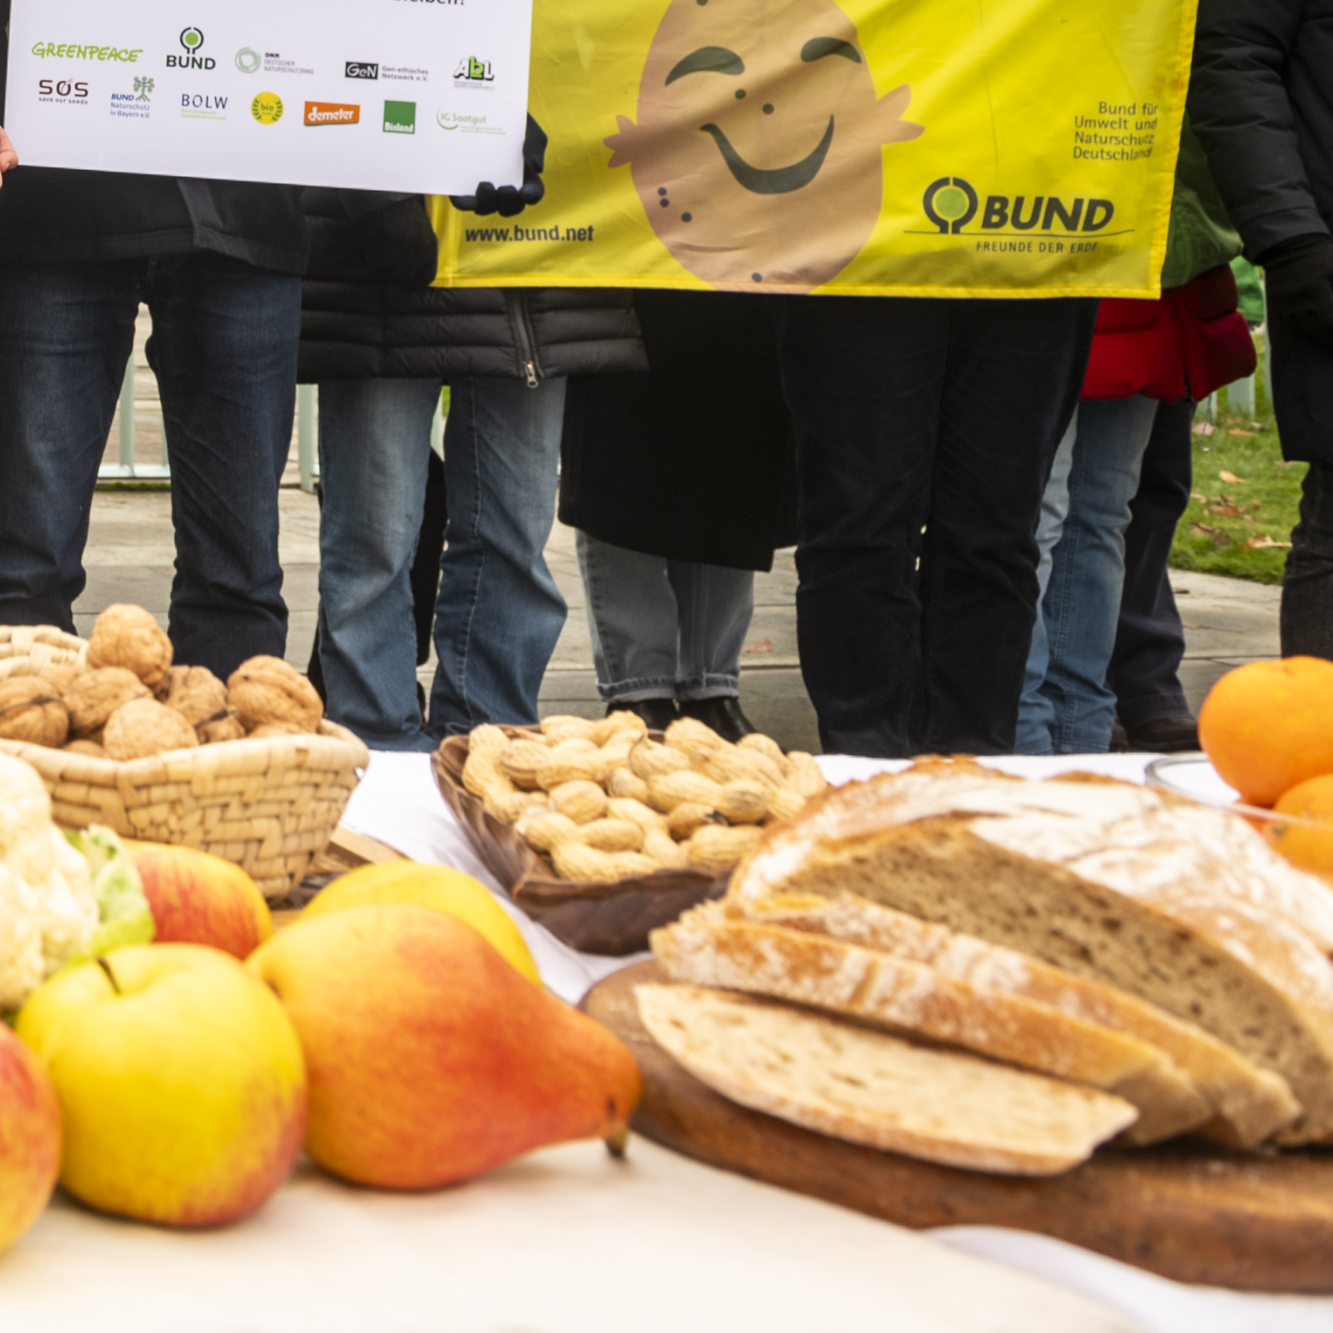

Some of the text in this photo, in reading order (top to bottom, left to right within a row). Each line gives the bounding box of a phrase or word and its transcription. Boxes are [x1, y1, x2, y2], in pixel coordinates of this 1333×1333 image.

[31, 42, 143, 62] GREENPEACE
[166, 55, 216, 70] BUND
[453, 56, 494, 81] AbL
[346, 63, 377, 78] GeN
[39, 79, 88, 97] SOS
[111, 93, 134, 101] BUND
[261, 103, 274, 112] bio
[308, 107, 353, 122] demeter
[1099, 102, 1136, 115] Bund
[1075, 116, 1157, 130] Umwelt und
[1075, 132, 1154, 146] Naturschutz
[1073, 146, 1153, 160] Deutschland
[981, 195, 1115, 231] BUND
[465, 223, 594, 243] www.bund.net
[976, 241, 1099, 253] FREUNDE DER ERDE
